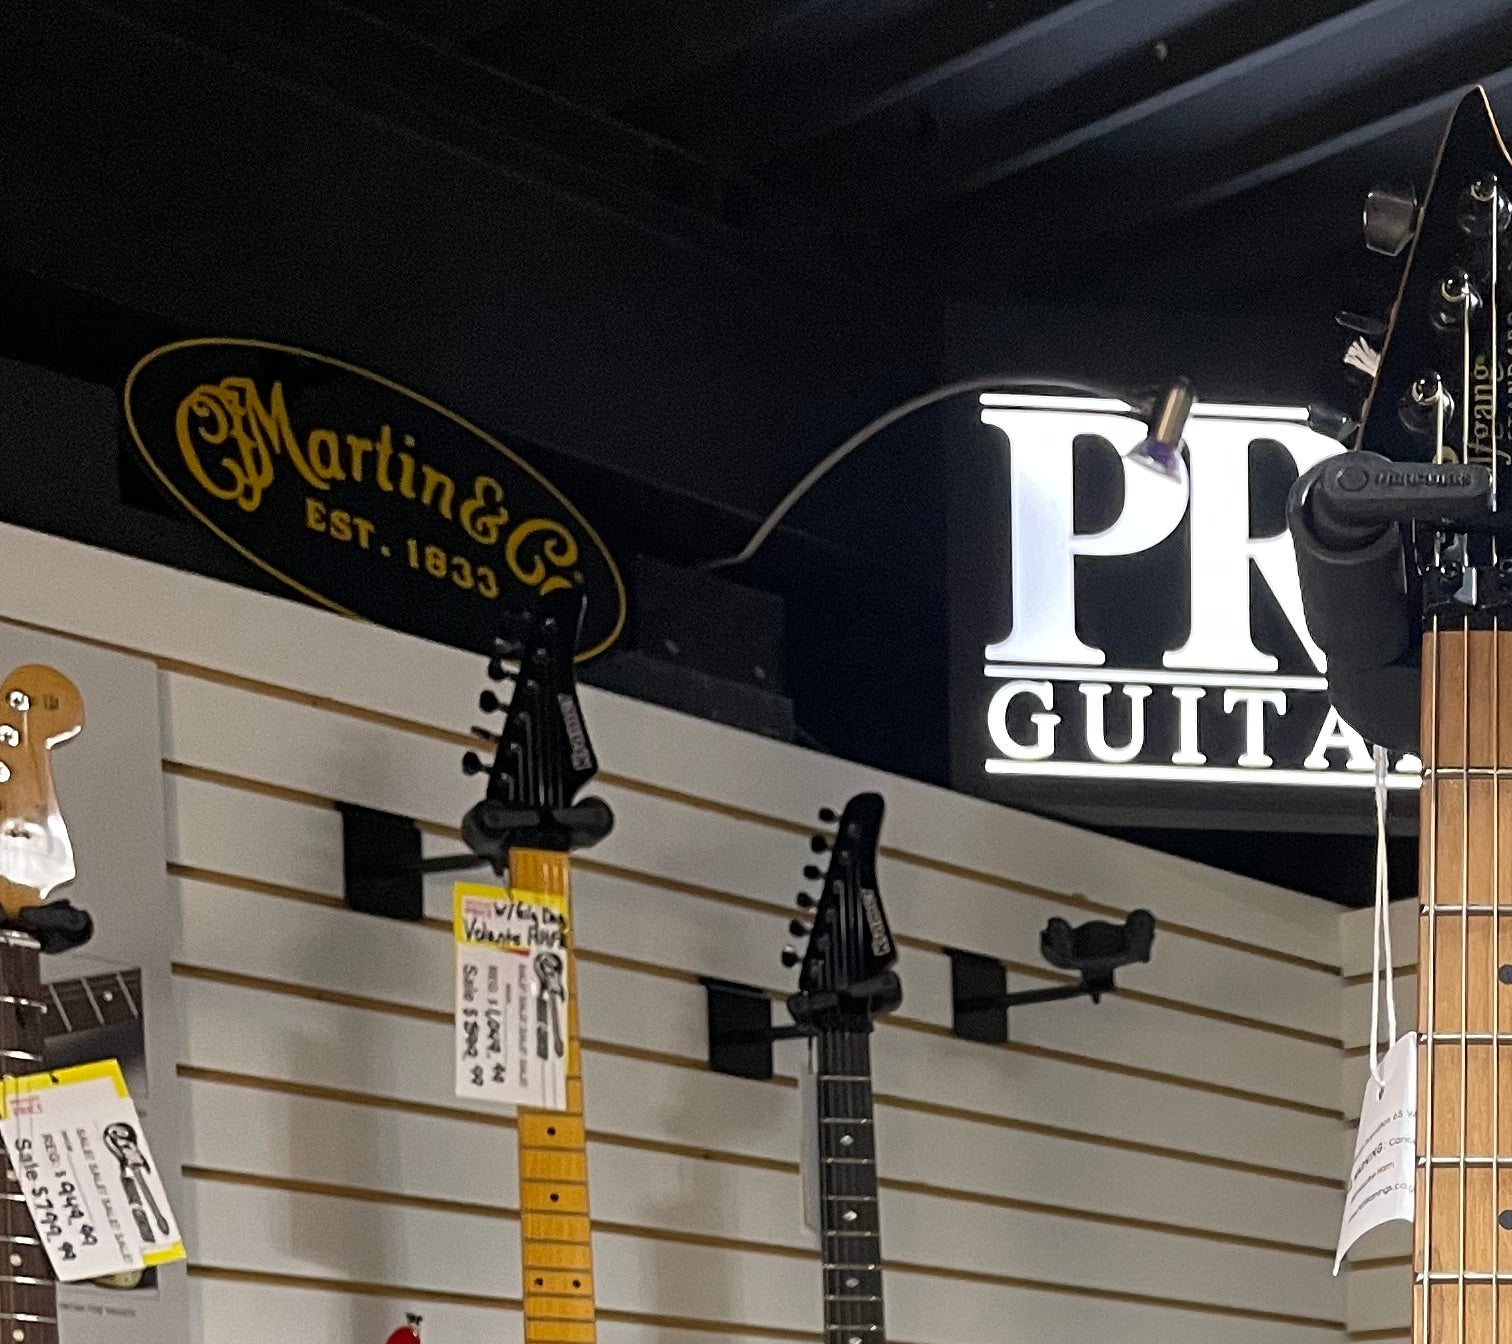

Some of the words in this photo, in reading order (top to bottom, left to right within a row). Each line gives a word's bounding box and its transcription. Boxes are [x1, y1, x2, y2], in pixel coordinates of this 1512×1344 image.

[306, 498, 392, 558] EST.
[407, 538, 501, 600] 1833
[987, 680, 1421, 772] GUITA
[15, 1137, 39, 1181] Sale
